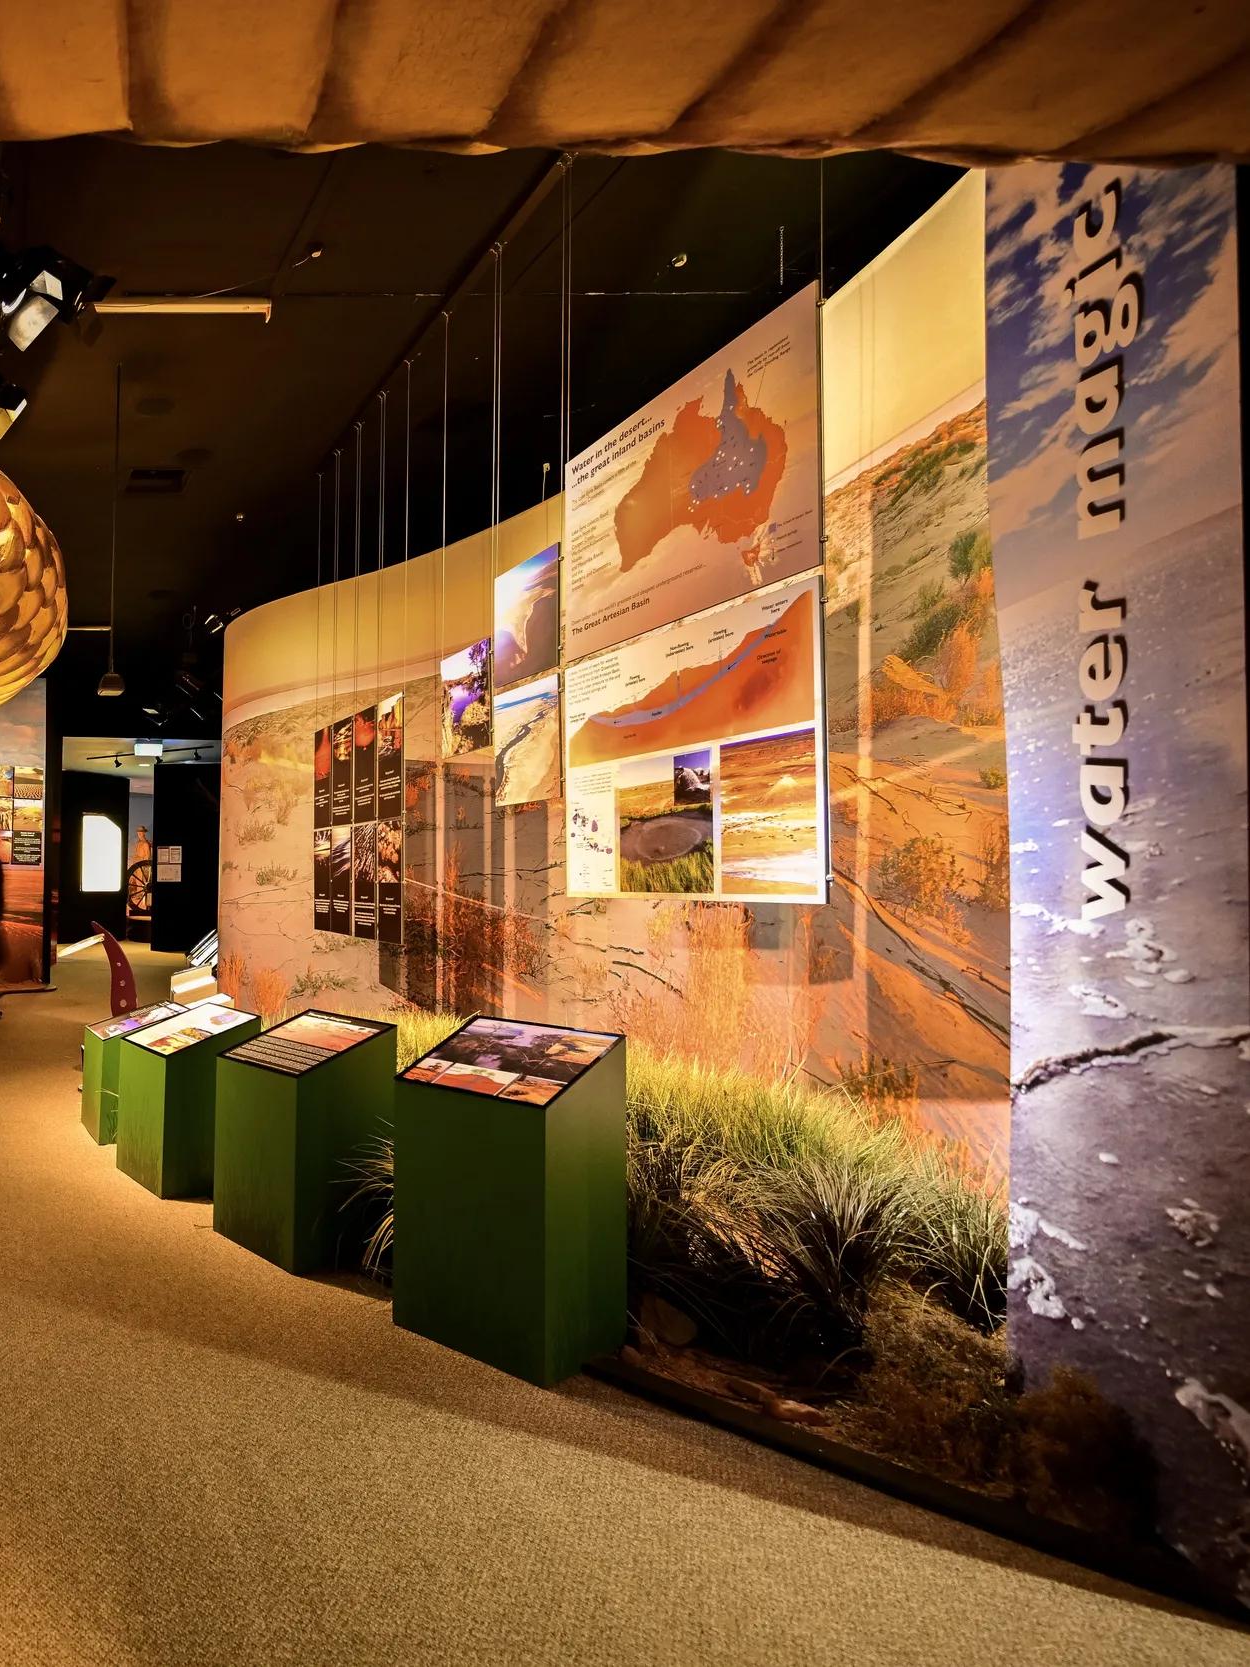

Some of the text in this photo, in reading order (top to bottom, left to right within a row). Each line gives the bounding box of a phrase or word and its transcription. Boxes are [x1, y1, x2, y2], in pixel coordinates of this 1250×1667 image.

[571, 454, 594, 475] Water
[595, 449, 603, 458] in
[604, 439, 617, 453] the
[590, 457, 610, 478] great
[612, 438, 636, 461] inland
[638, 419, 665, 443] basins
[1060, 182, 1141, 922] water magic
[572, 628, 583, 636] The
[584, 618, 601, 631] Great
[602, 606, 630, 623] Artesian
[631, 597, 650, 611] Basin
